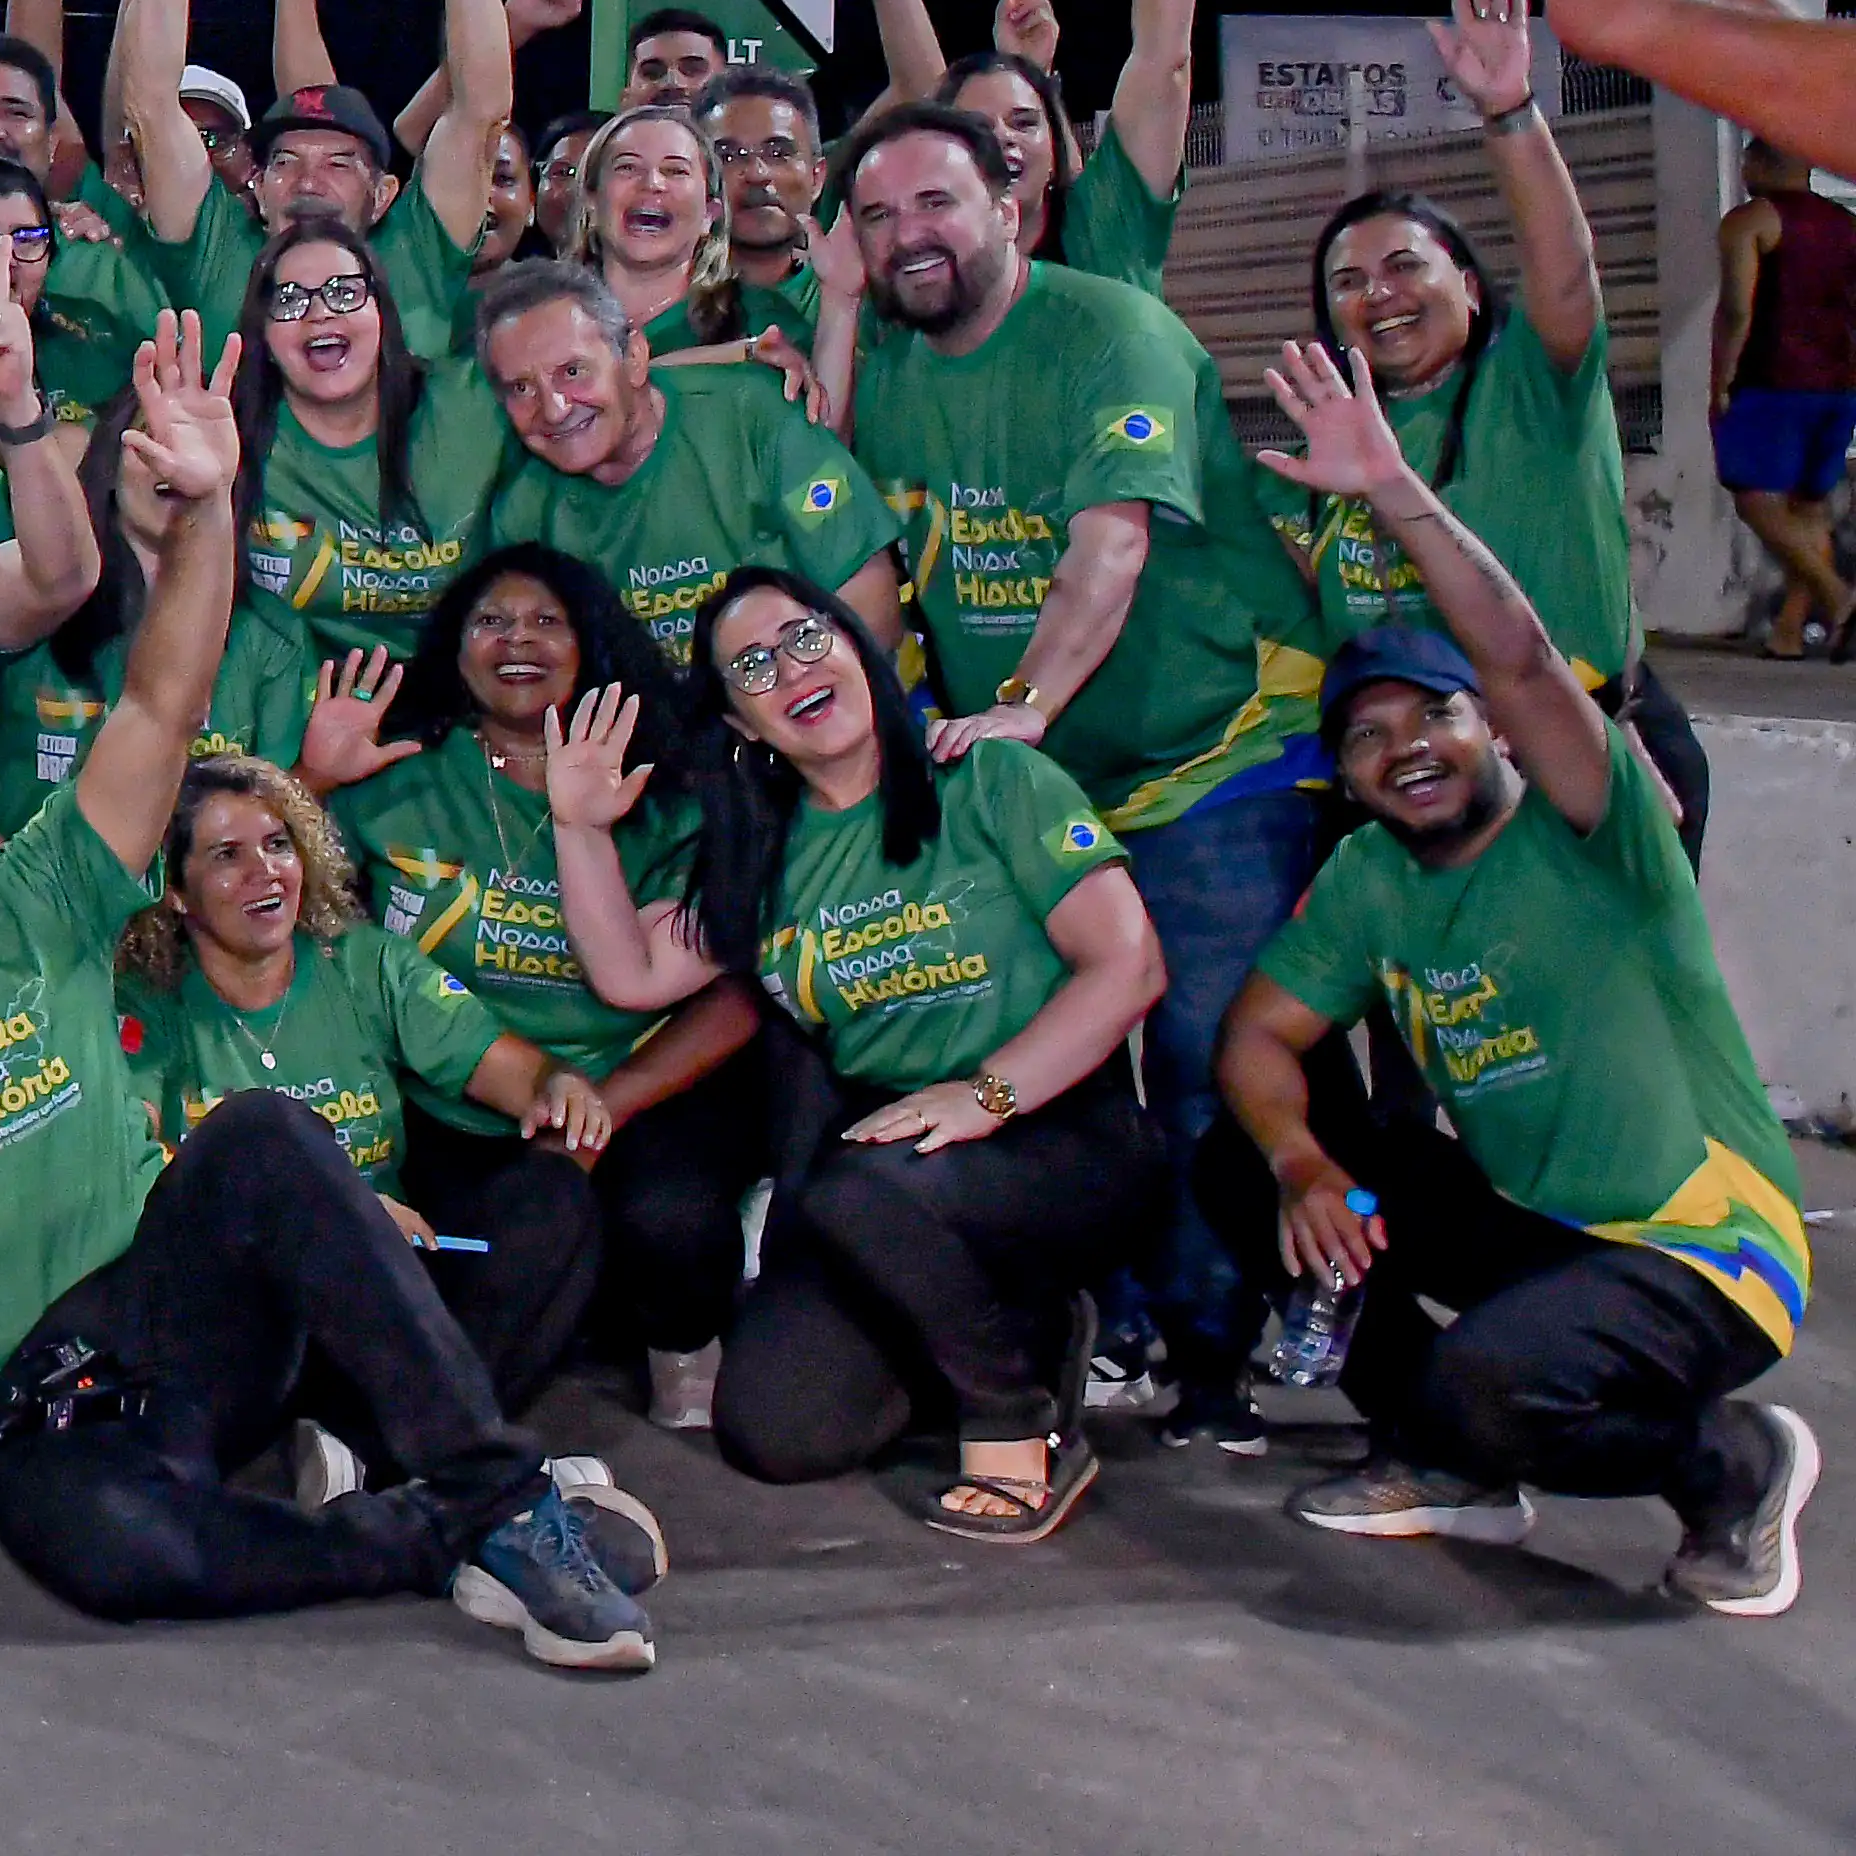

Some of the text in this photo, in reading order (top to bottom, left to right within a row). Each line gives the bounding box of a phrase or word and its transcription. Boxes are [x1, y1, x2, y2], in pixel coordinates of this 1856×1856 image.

[629, 556, 709, 589] Nossa
[819, 888, 903, 930] Nossa
[476, 918, 570, 955] Noss
[821, 901, 952, 963] Escola
[827, 943, 915, 986] Nossa
